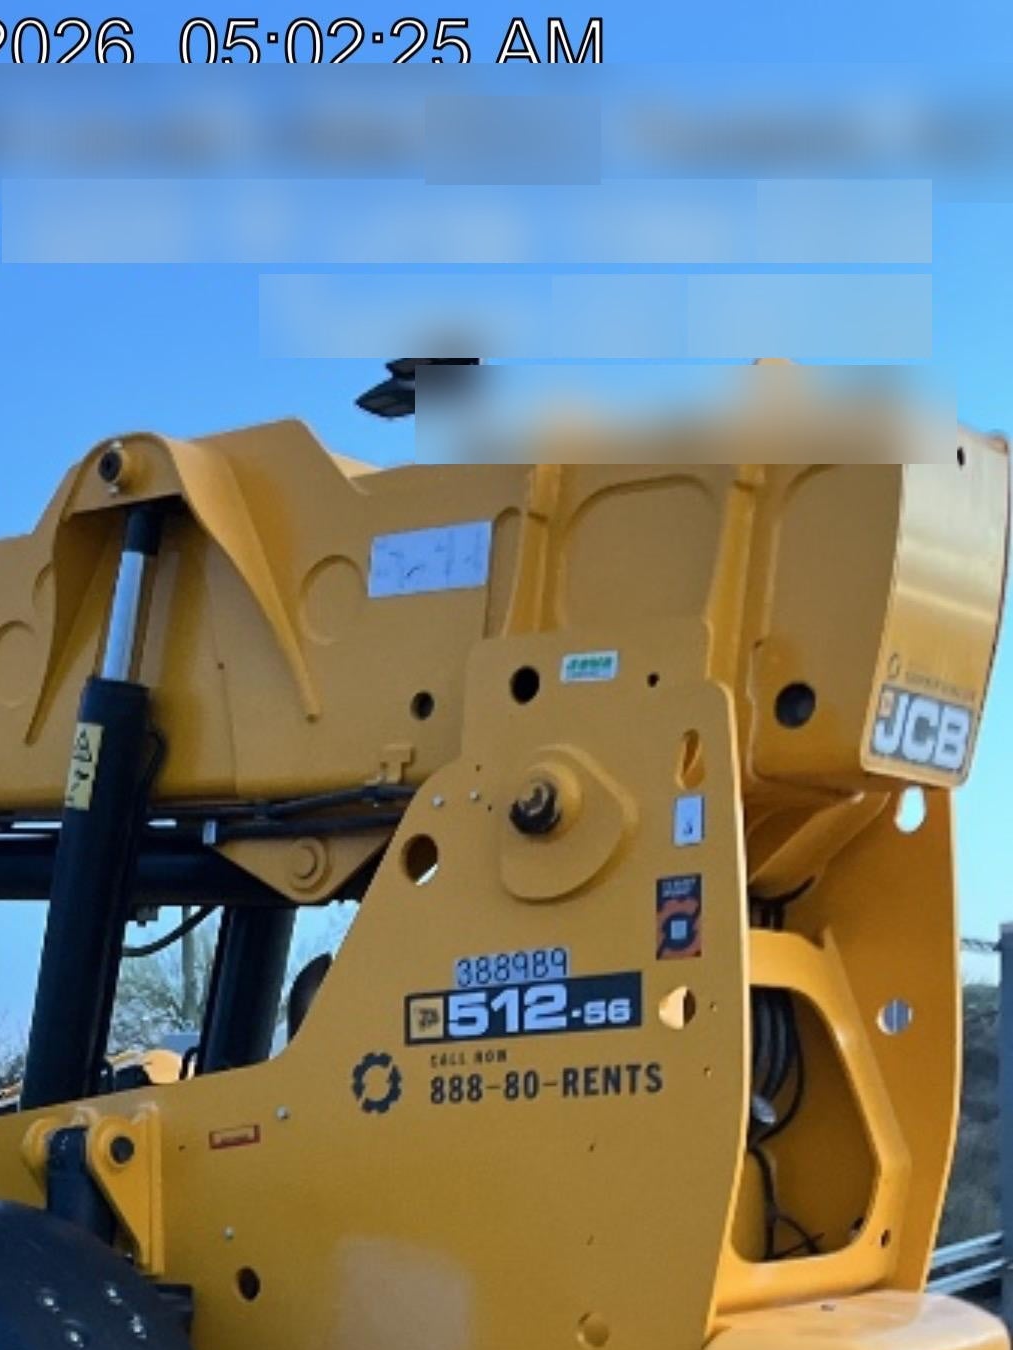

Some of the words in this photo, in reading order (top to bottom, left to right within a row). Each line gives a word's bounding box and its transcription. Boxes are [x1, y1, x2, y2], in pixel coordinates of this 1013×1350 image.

[873, 692, 970, 769] JCB
[457, 948, 568, 987] 388989
[430, 1063, 663, 1104] 888-80-RENTS
